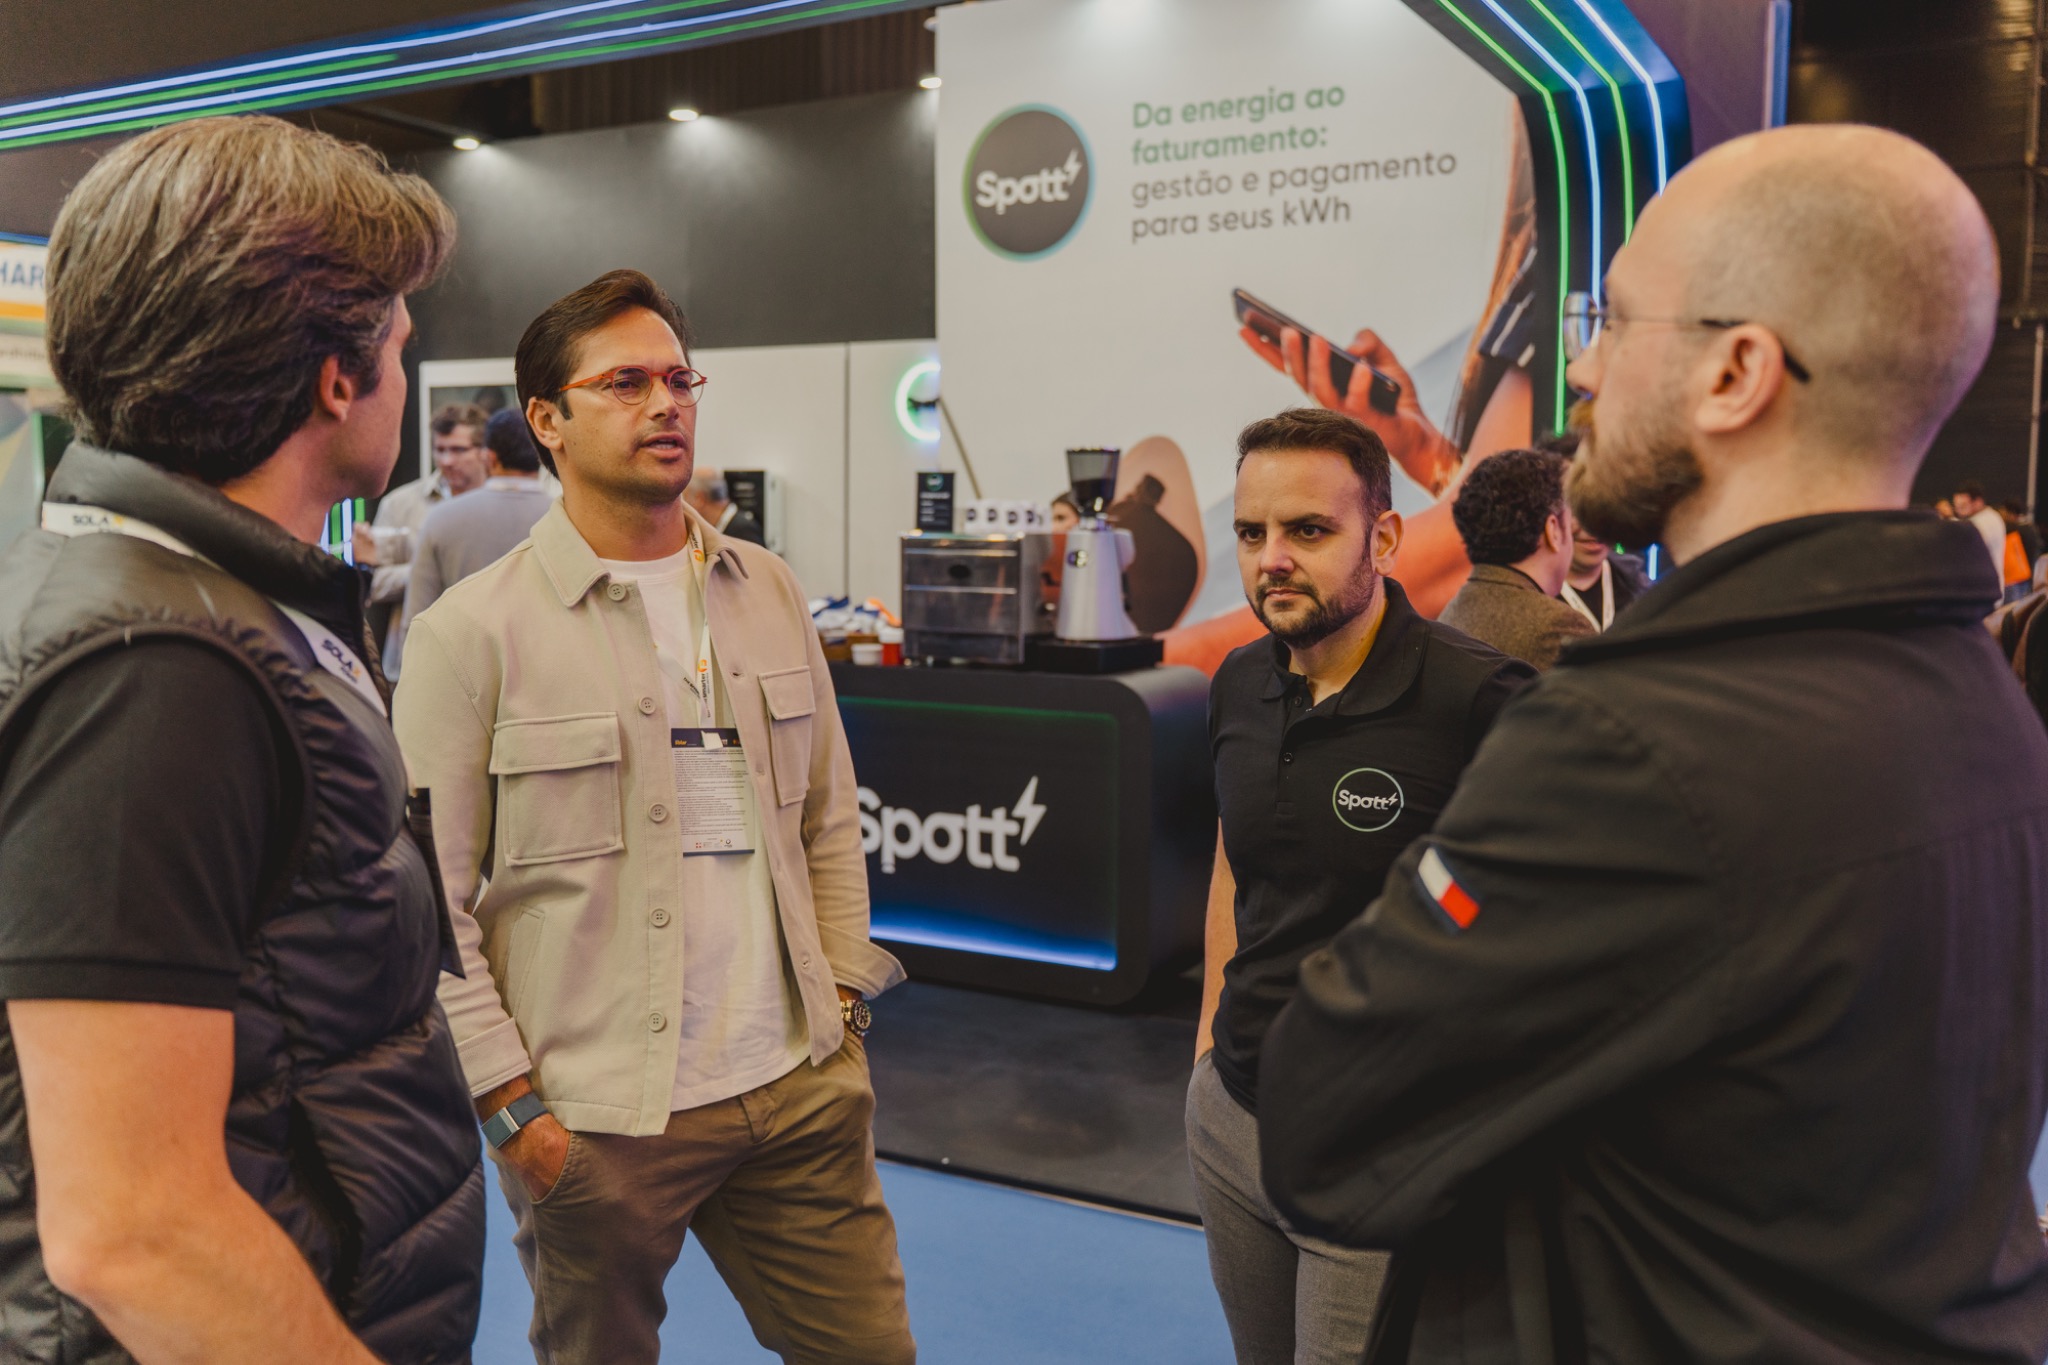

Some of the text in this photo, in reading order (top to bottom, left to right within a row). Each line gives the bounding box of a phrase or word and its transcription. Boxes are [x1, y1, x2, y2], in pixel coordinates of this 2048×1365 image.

[1132, 84, 1345, 128] Da energia ao
[1131, 125, 1327, 165] faturamento:
[976, 166, 1070, 216] Spott
[1132, 151, 1457, 208] gestão e pagamento
[1132, 196, 1351, 245] para seus kWh
[1338, 789, 1389, 810] Spott
[856, 786, 1021, 873] Spott
